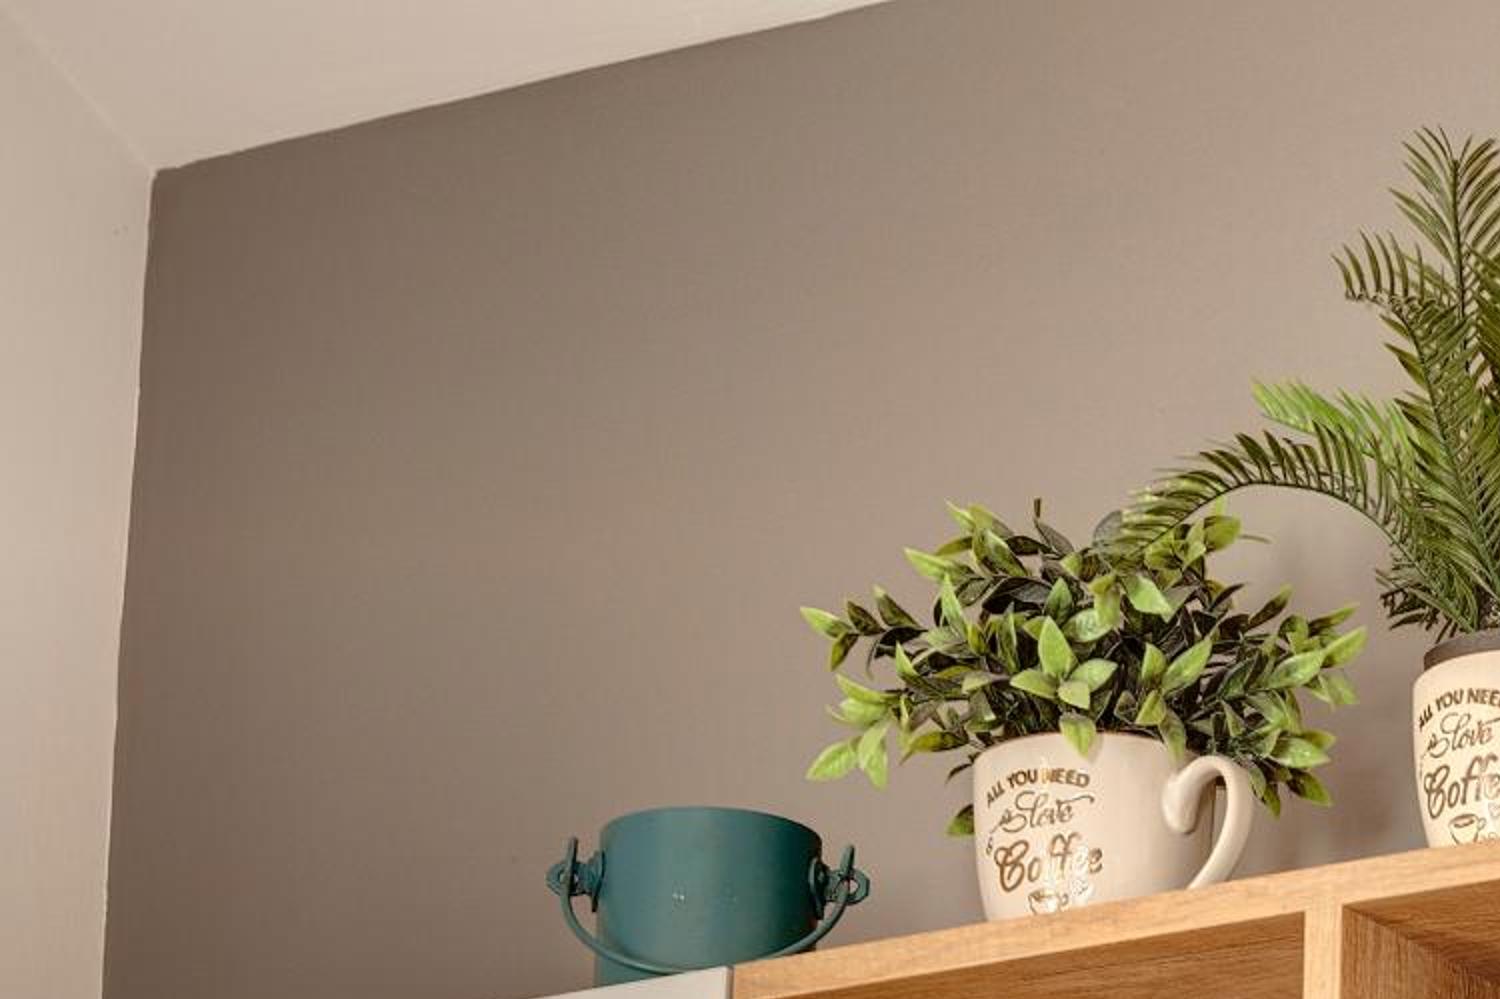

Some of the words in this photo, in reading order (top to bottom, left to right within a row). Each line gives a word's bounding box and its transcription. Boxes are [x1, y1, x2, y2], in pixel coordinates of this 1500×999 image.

[1418, 705, 1433, 732] ALL
[1436, 688, 1464, 711] YOU
[986, 781, 1006, 808] ALL
[1007, 768, 1038, 788] YOU
[1041, 768, 1091, 788] NEED
